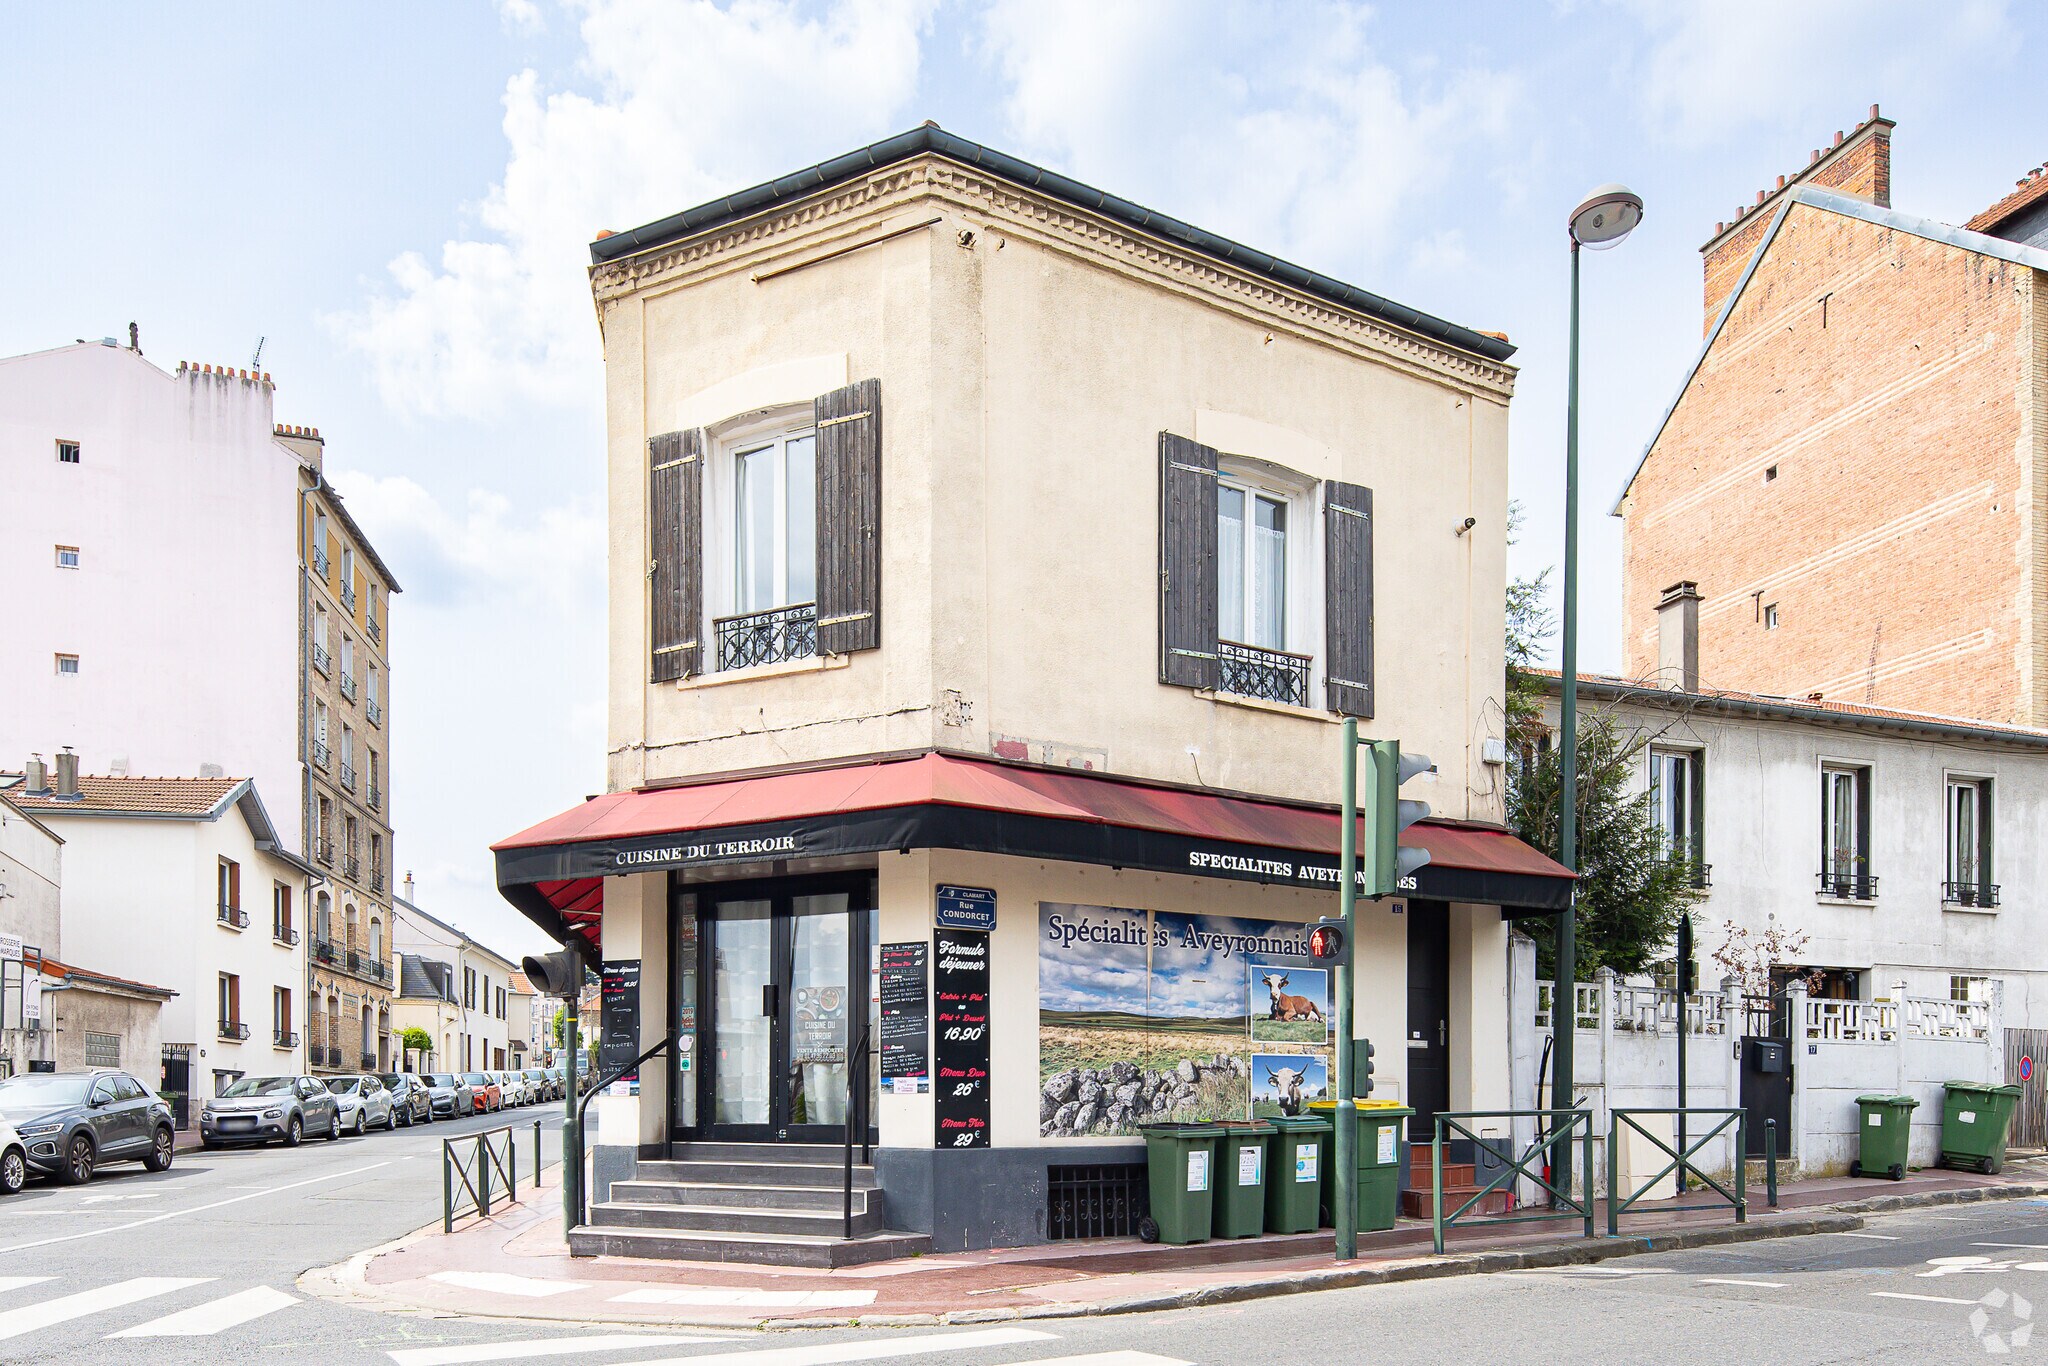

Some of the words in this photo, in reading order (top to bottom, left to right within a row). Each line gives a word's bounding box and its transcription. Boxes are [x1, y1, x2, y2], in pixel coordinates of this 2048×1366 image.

[616, 848, 682, 865] CUISINE
[686, 844, 710, 859] DU
[715, 836, 794, 856] TERROIR
[1189, 852, 1292, 877] SPECIALITES
[962, 892, 986, 900] CLAMART
[959, 901, 974, 910] Rue
[943, 910, 990, 921] CONDORCET
[940, 940, 986, 956] Formule
[939, 956, 986, 974] déjeuner
[940, 992, 960, 1001] Entrée
[968, 994, 984, 1002] Plat
[939, 1014, 954, 1022] Plat
[962, 1014, 986, 1022] Dessert
[805, 1021, 826, 1029] CUISINE
[809, 1032, 832, 1040] TERROIR
[940, 1068, 966, 1077] Menu
[966, 1068, 986, 1077] Duo
[942, 1118, 966, 1128] Menu
[968, 1118, 985, 1128] Trio
